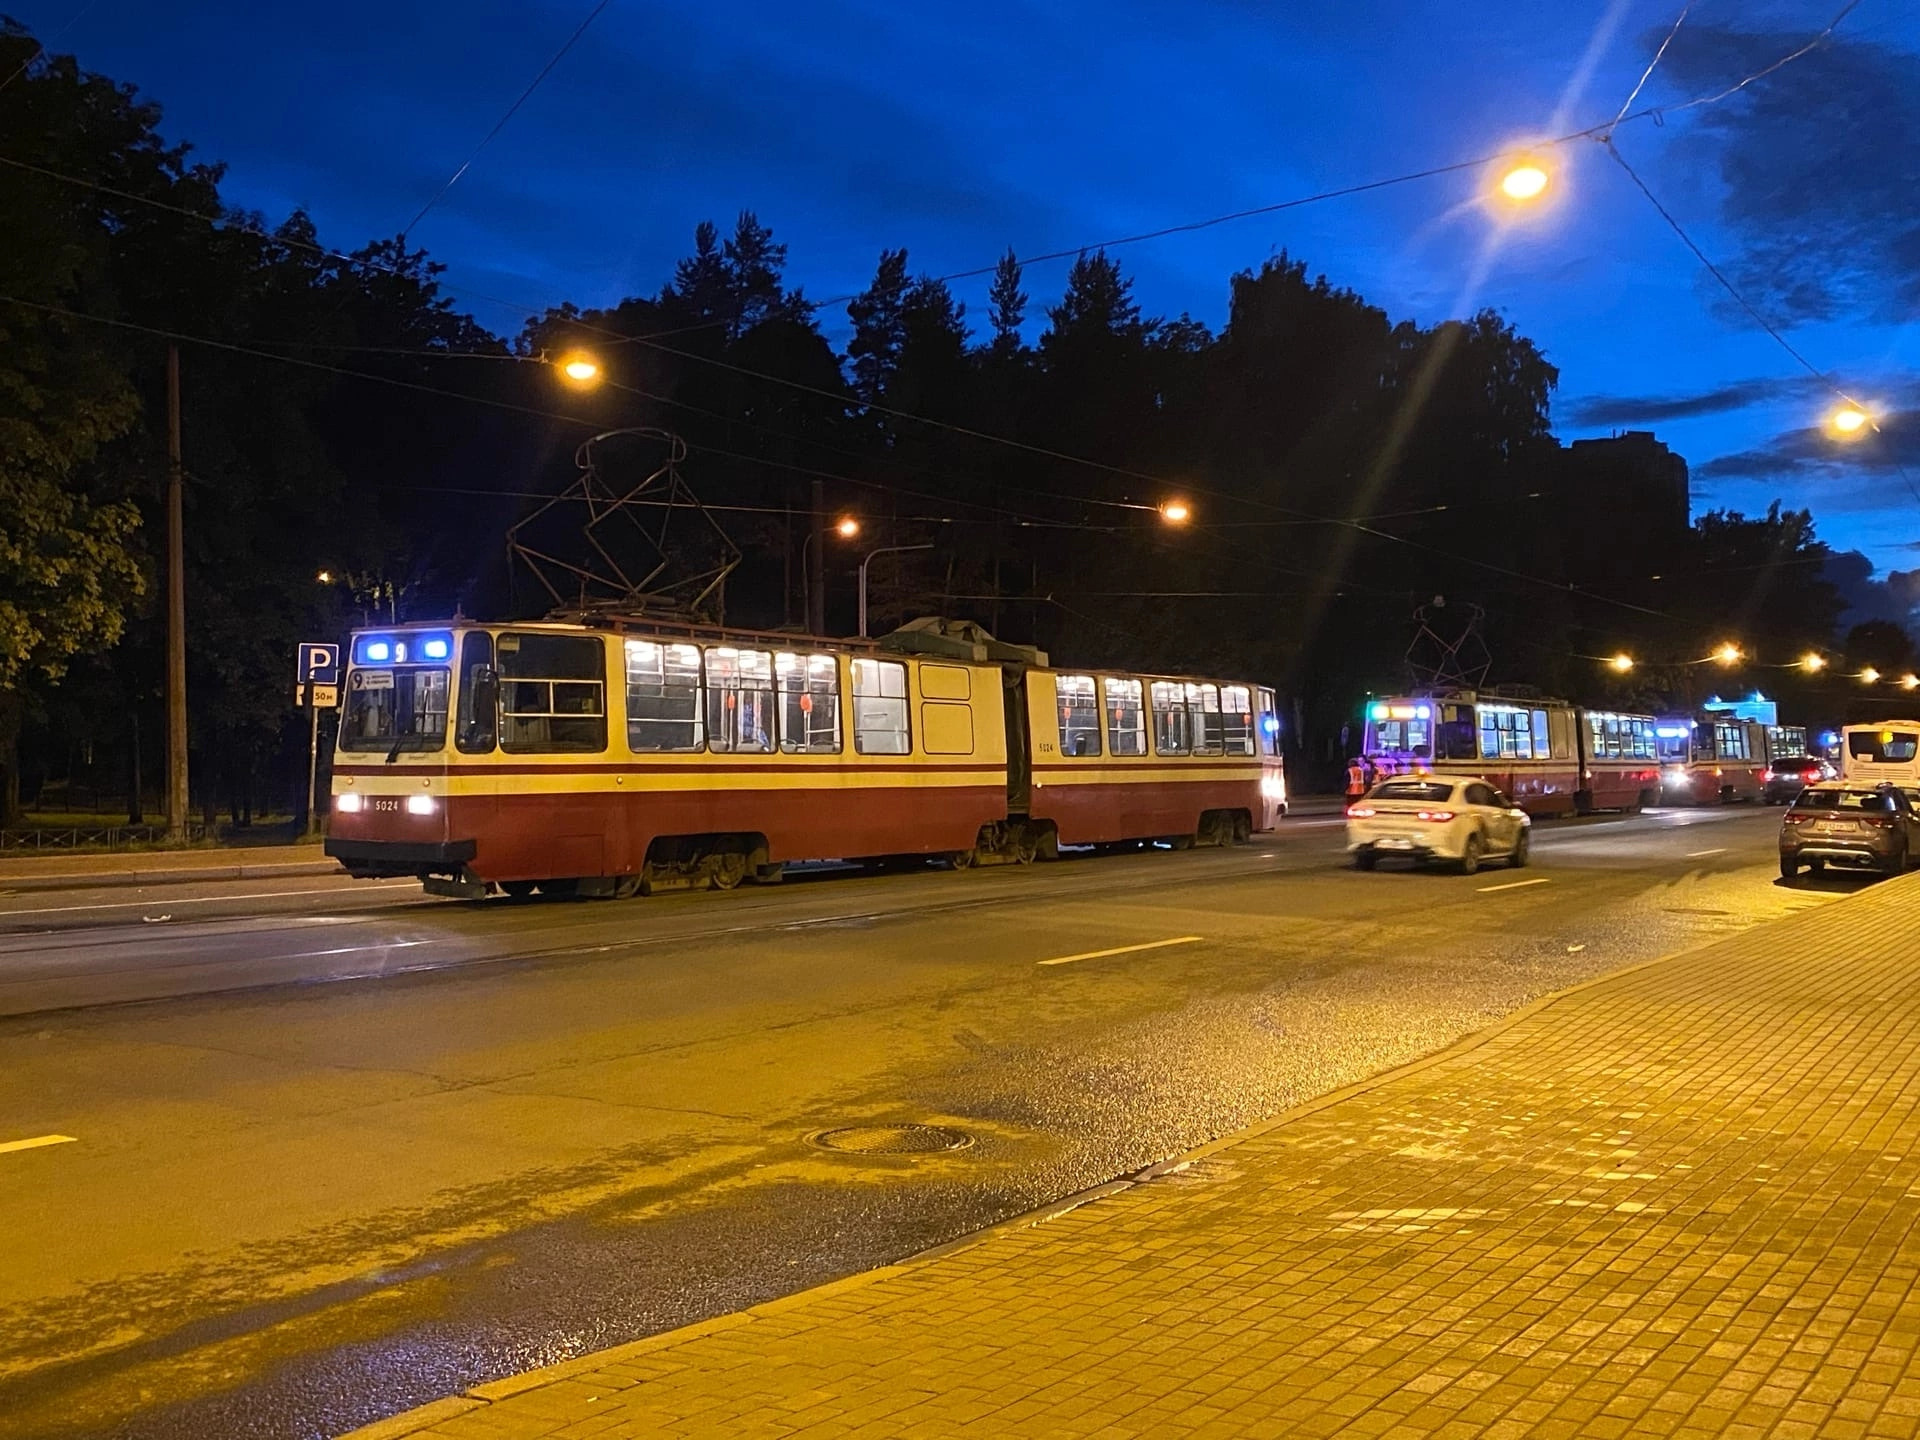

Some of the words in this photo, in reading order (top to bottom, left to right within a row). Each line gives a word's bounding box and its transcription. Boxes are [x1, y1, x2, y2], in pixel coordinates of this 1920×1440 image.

[395, 642, 406, 663] 9
[310, 648, 331, 680] P
[354, 673, 363, 689] 9
[375, 800, 398, 811] 5024
